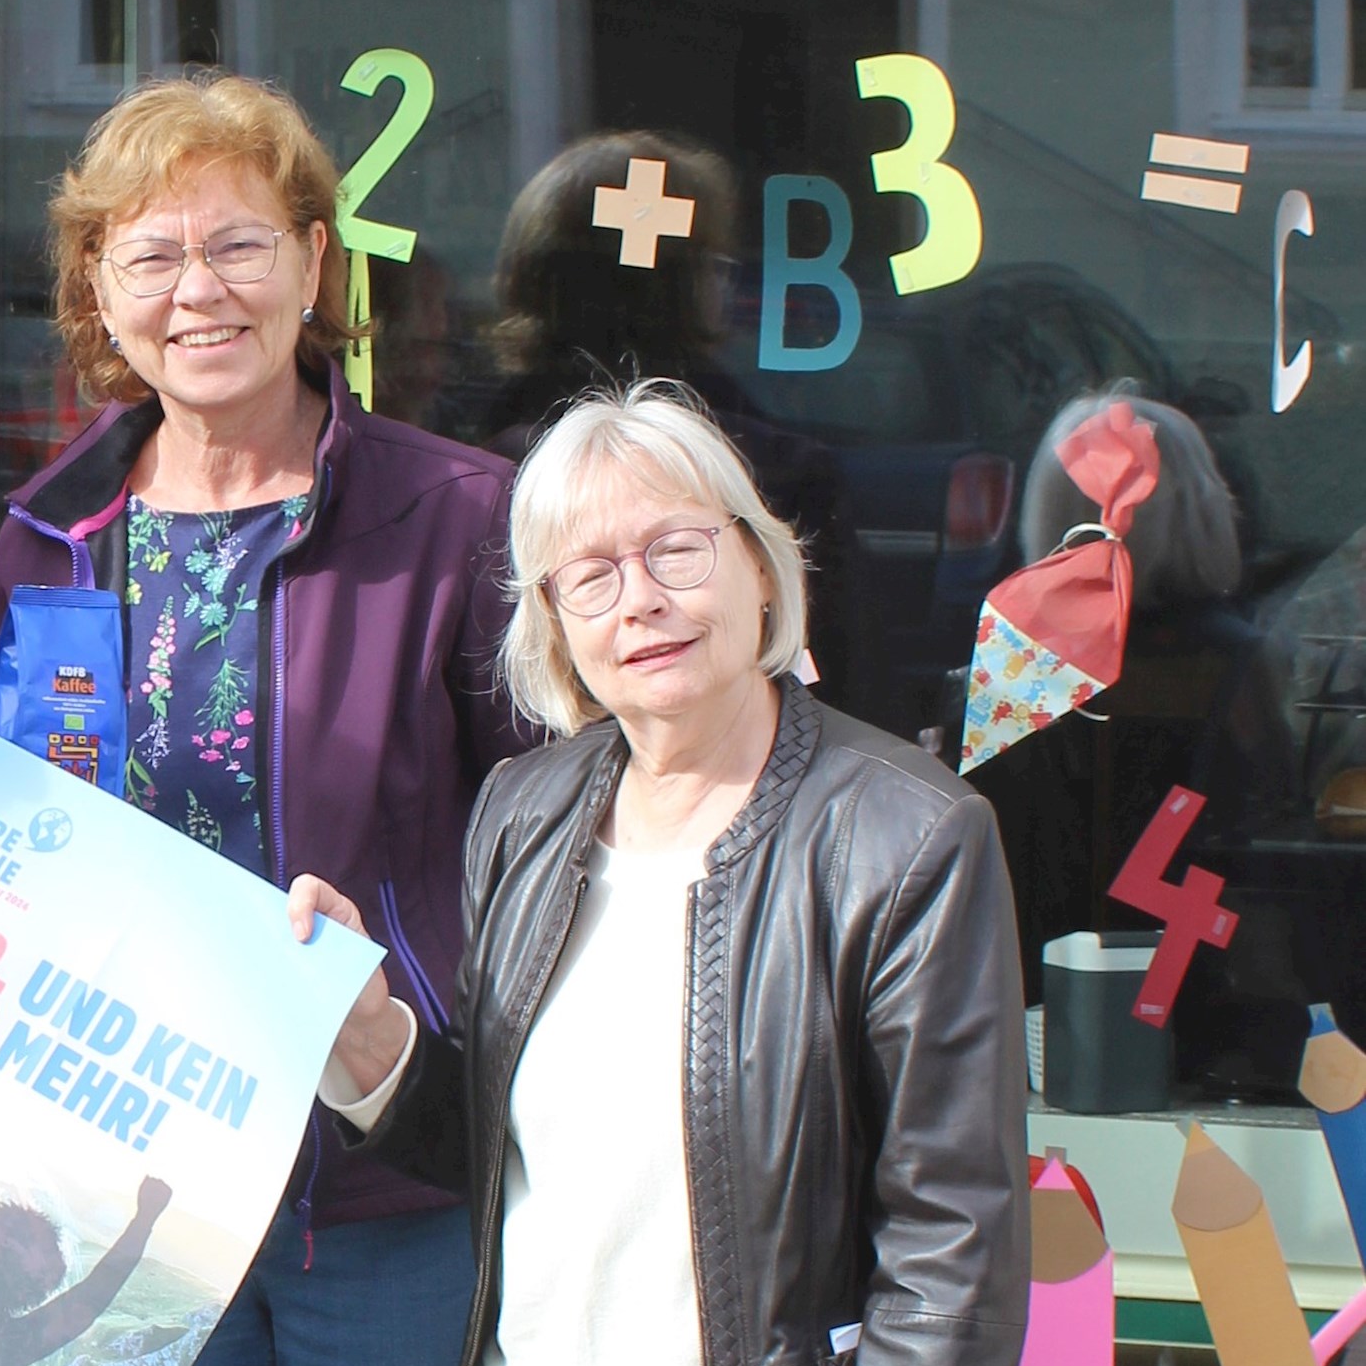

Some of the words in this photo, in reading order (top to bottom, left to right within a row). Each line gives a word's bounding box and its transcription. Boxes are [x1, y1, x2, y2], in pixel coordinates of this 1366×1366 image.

[336, 47, 435, 263] 2
[855, 53, 984, 296] 3
[758, 173, 864, 373] B
[53, 679, 96, 694] Kaffee
[7, 892, 29, 911] 2024
[1108, 783, 1240, 1029] 4
[18, 959, 138, 1057] UND
[132, 1024, 259, 1131] KEIN
